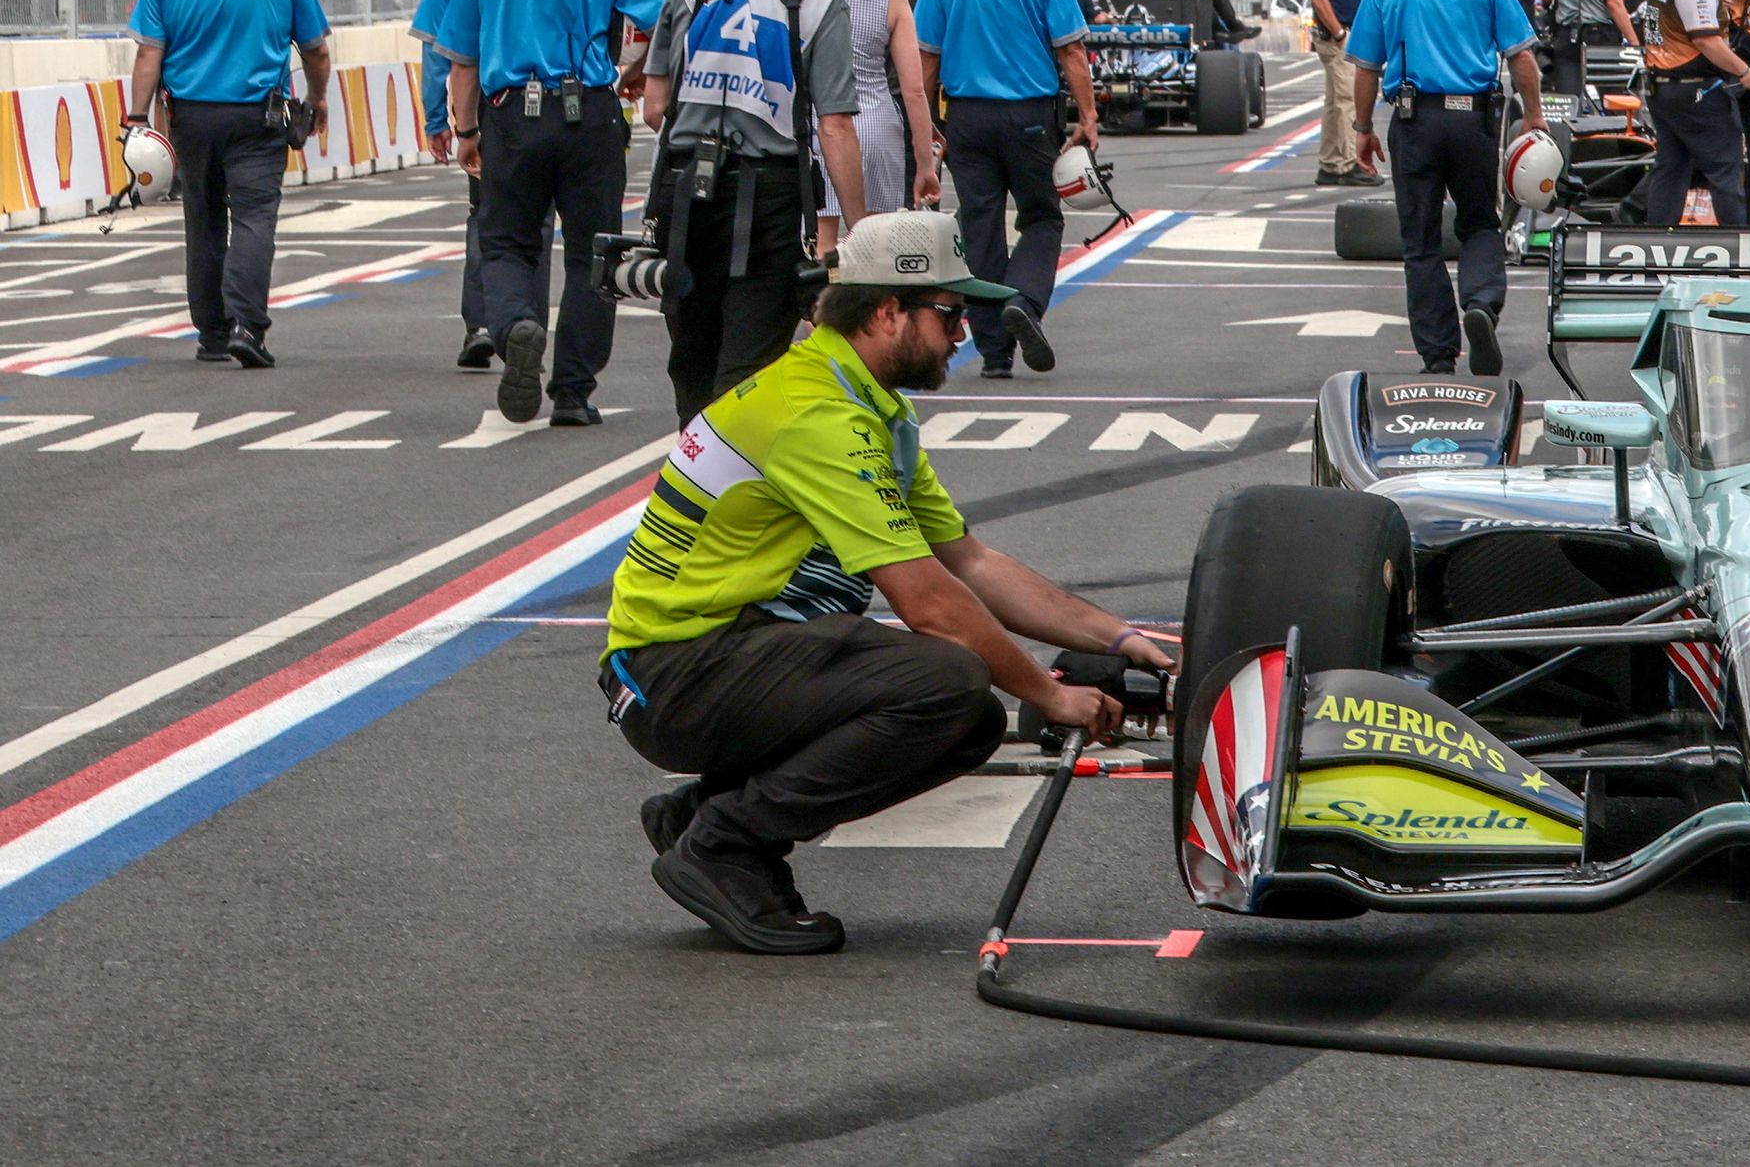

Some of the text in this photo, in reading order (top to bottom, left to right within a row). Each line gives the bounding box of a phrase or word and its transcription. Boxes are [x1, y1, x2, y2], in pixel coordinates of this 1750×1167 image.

[720, 1, 760, 53] 4
[1130, 26, 1180, 43] club
[1391, 386, 1486, 403] JAVA HOUSE
[1385, 414, 1485, 434] Splenda
[1398, 453, 1467, 461] LIQUID
[1313, 694, 1507, 773] AMERICA'S
[1343, 728, 1474, 770] STEVIA
[1304, 800, 1529, 831] Splenda
[1375, 829, 1470, 840] STEVIA
